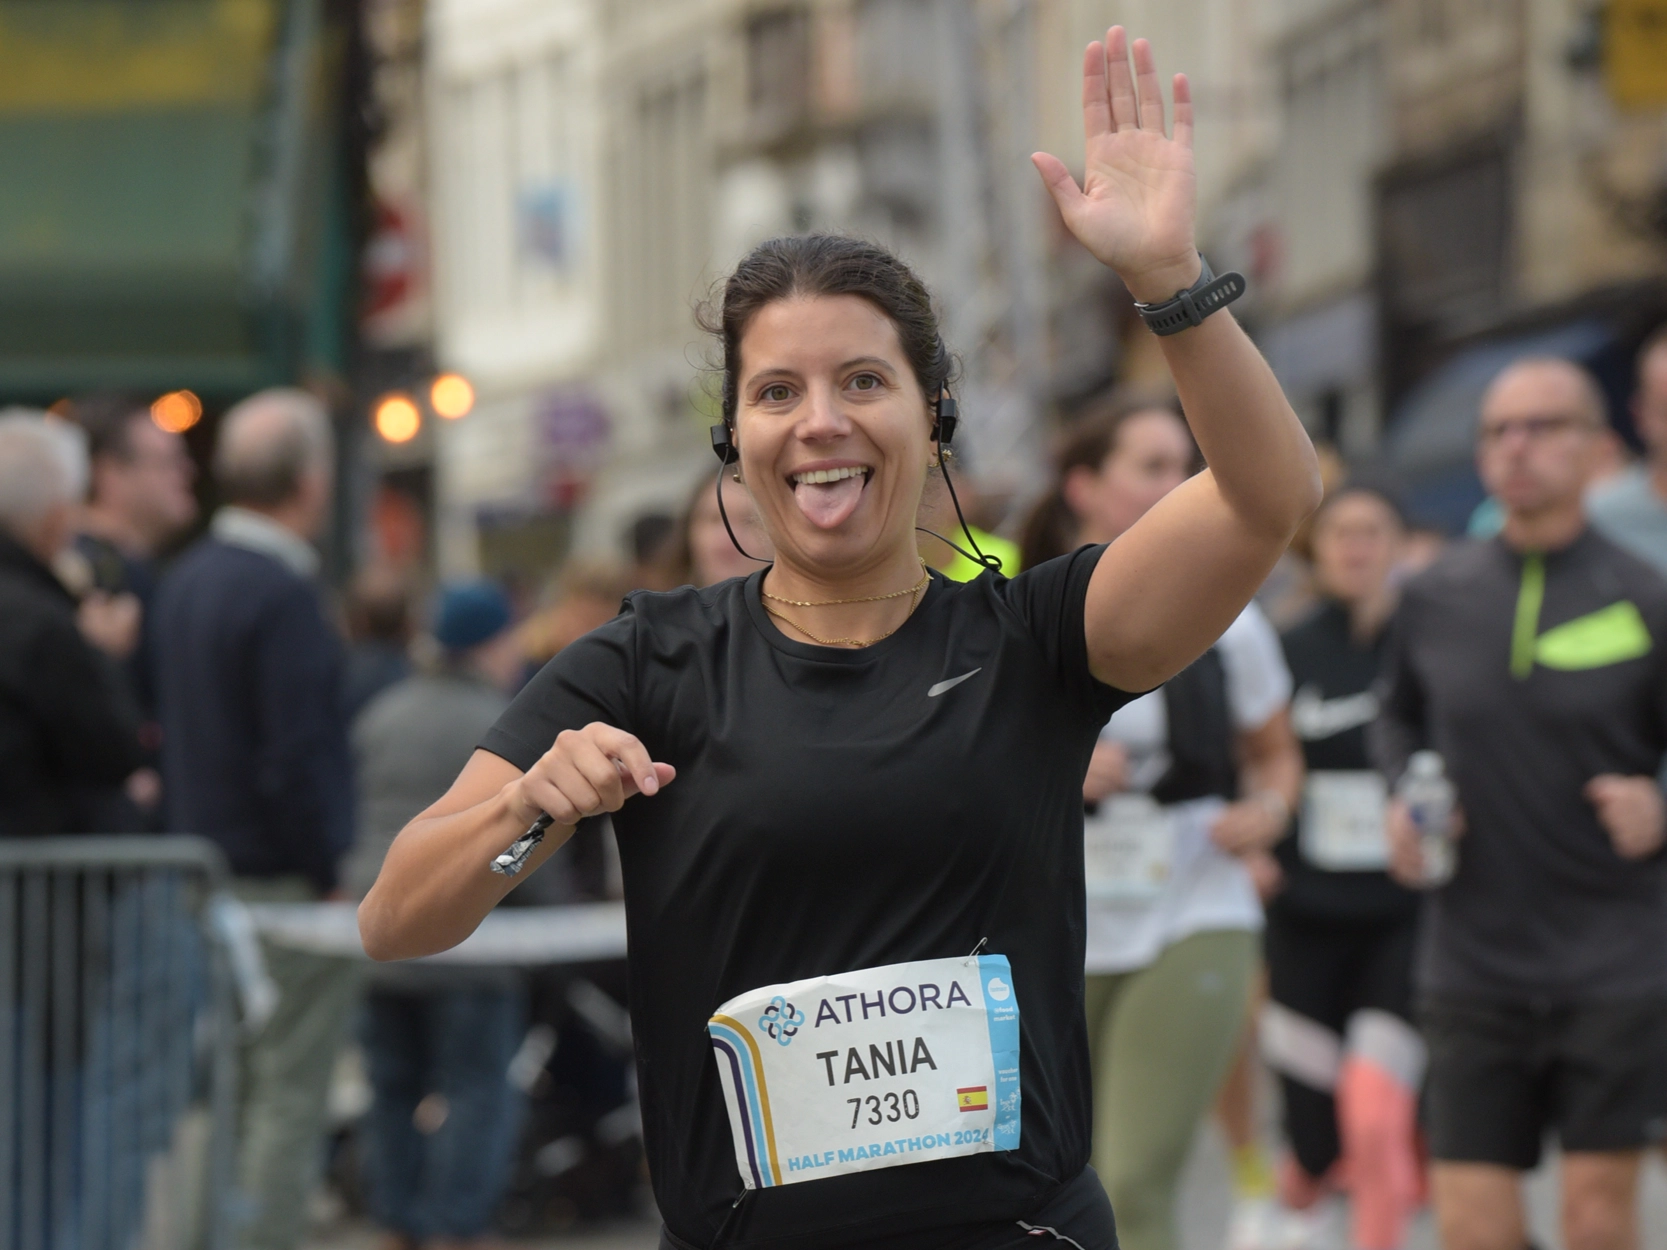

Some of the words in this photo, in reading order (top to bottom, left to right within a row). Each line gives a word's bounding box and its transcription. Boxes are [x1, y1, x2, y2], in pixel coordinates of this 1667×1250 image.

[815, 981, 972, 1028] ATHORA
[816, 1037, 937, 1087] TANIA
[847, 1089, 919, 1129] 7330
[788, 1151, 834, 1171] HALF
[838, 1133, 950, 1163] MARATHON
[954, 1128, 989, 1145] 2024
